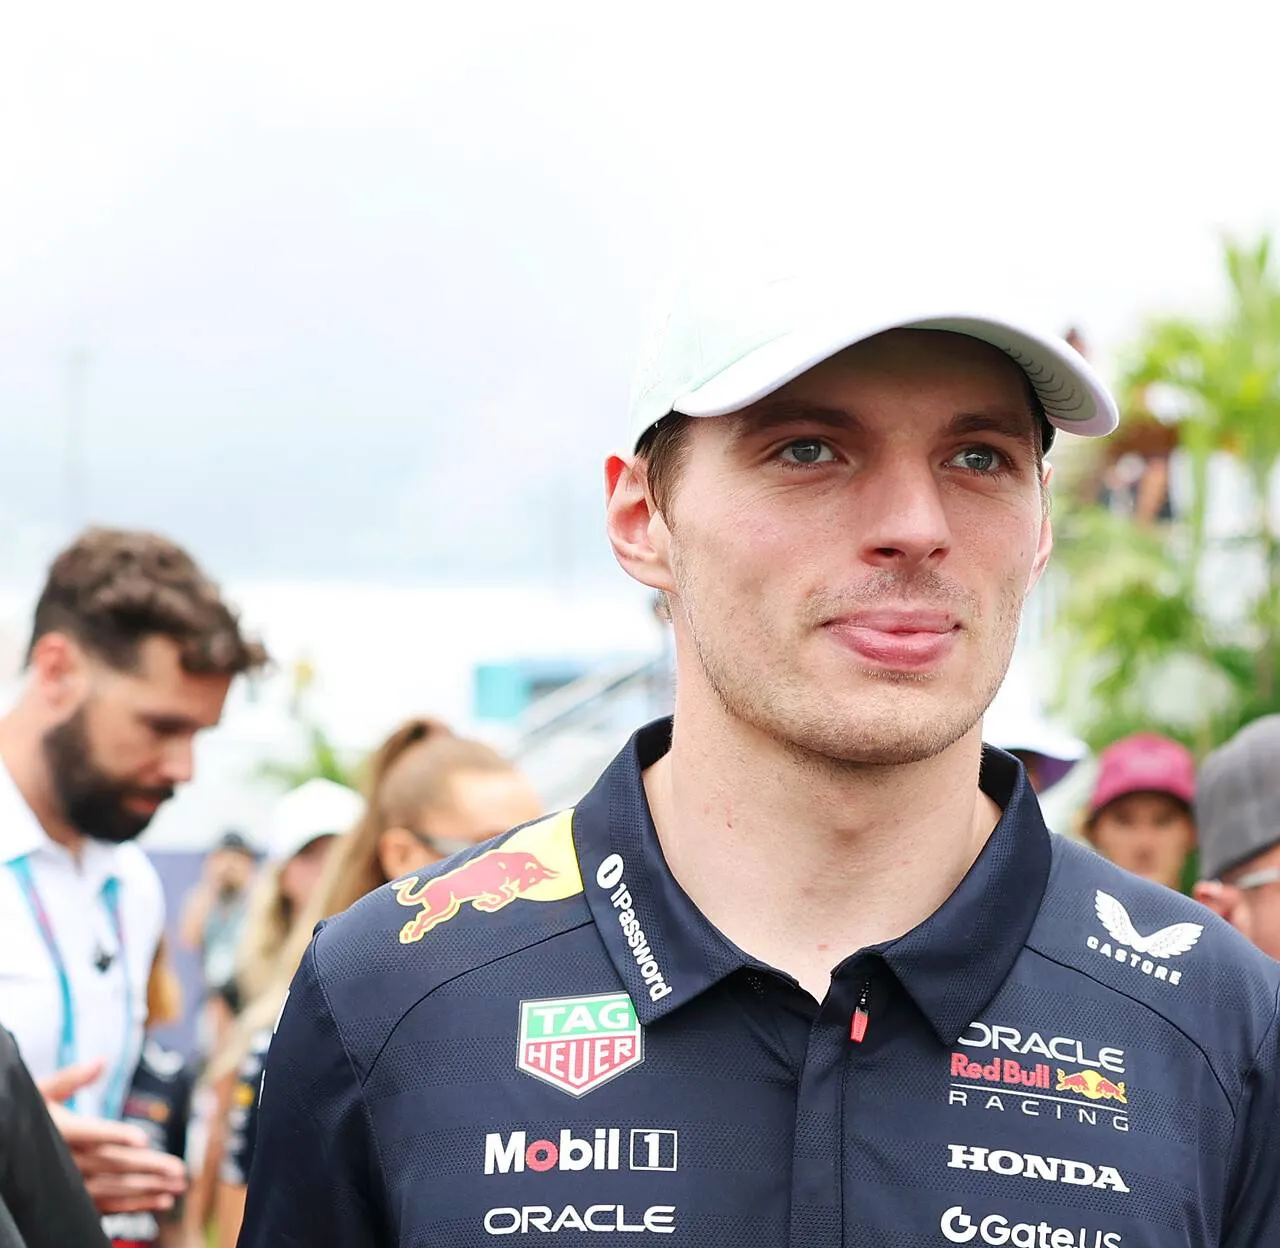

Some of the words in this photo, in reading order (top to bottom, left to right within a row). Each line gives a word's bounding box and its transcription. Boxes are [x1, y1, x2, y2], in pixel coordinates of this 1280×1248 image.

[610, 882, 673, 1002] 1Password
[1086, 936, 1182, 986] CASTORE
[532, 1001, 630, 1035] TAG
[527, 1037, 635, 1086] HEUER
[957, 1021, 1126, 1074] ORACLE
[948, 1090, 1129, 1132] RACING
[484, 1128, 620, 1175] Mobil
[946, 1144, 1130, 1193] HONDA
[483, 1204, 676, 1235] ORACLE
